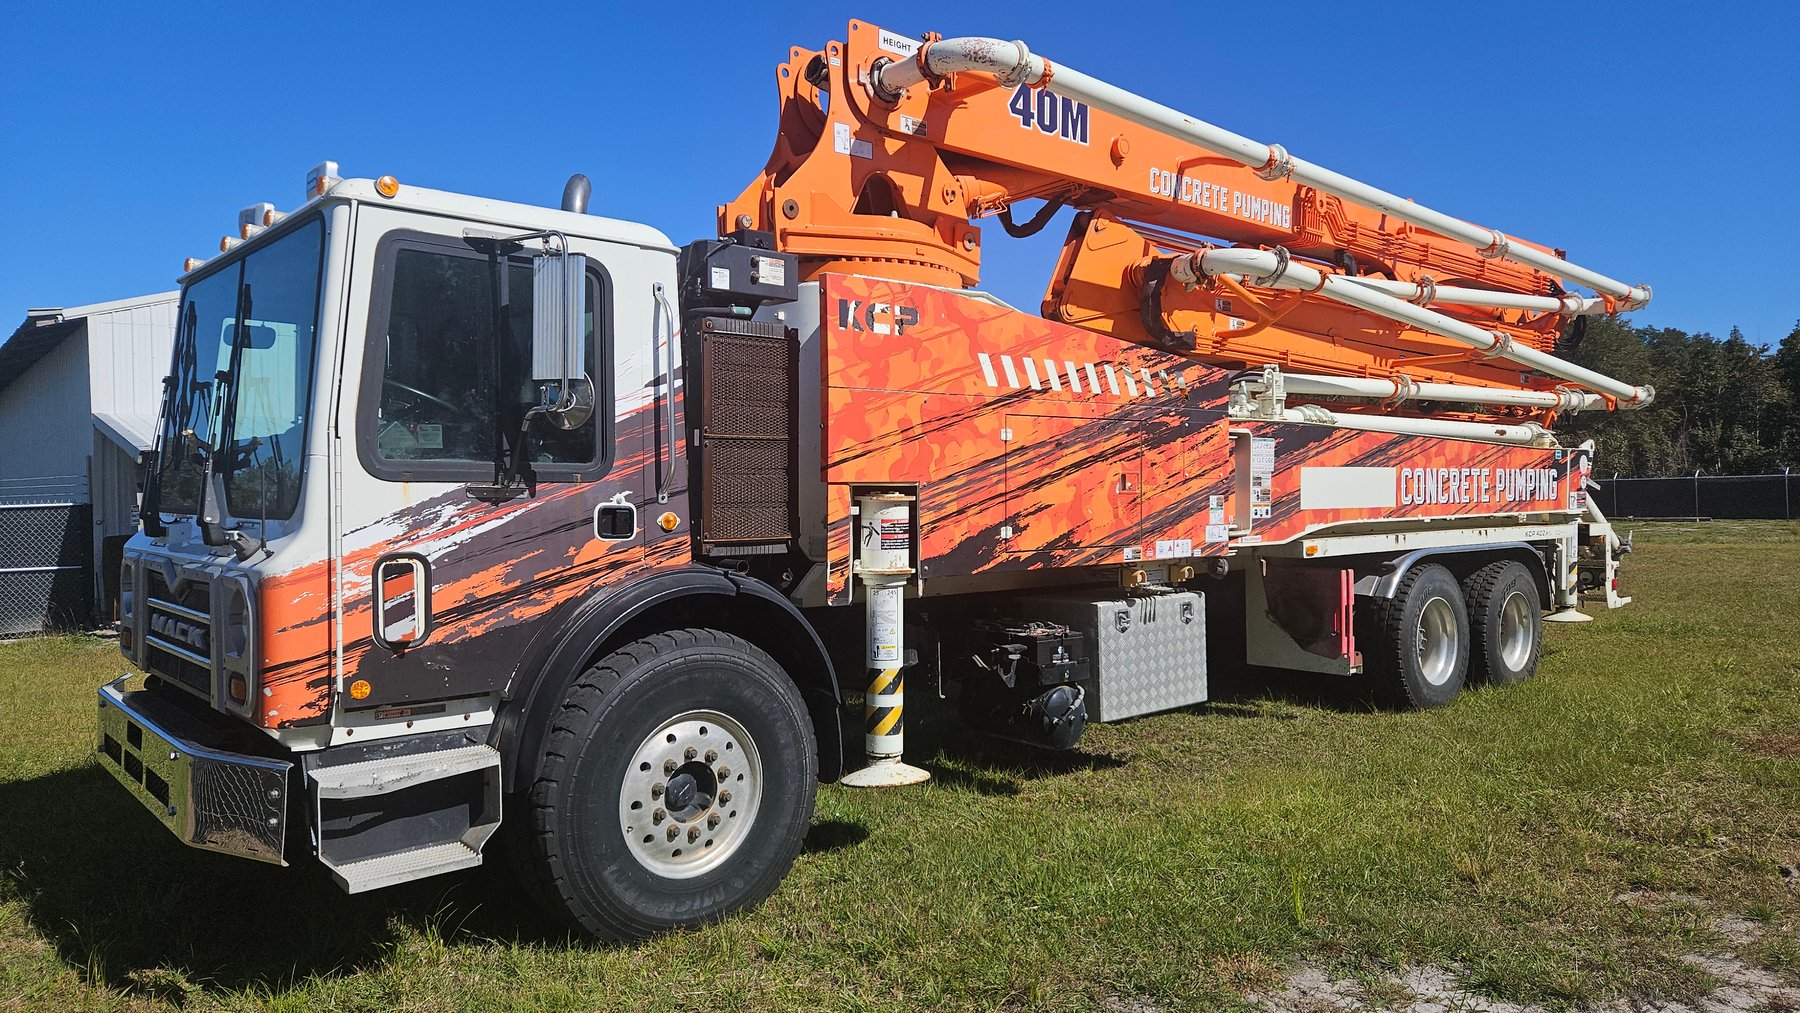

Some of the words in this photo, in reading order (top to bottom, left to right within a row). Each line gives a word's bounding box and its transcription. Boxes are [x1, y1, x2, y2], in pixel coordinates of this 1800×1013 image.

[883, 36, 912, 53] HEIGHT
[1008, 83, 1090, 146] 40M
[1150, 167, 1229, 213] CONCRETE
[1233, 191, 1292, 230] PUMPING
[838, 298, 920, 336] KCP
[1400, 467, 1491, 506] CONCRETE
[1495, 467, 1559, 503] PUMPING
[150, 613, 207, 650] MACK
